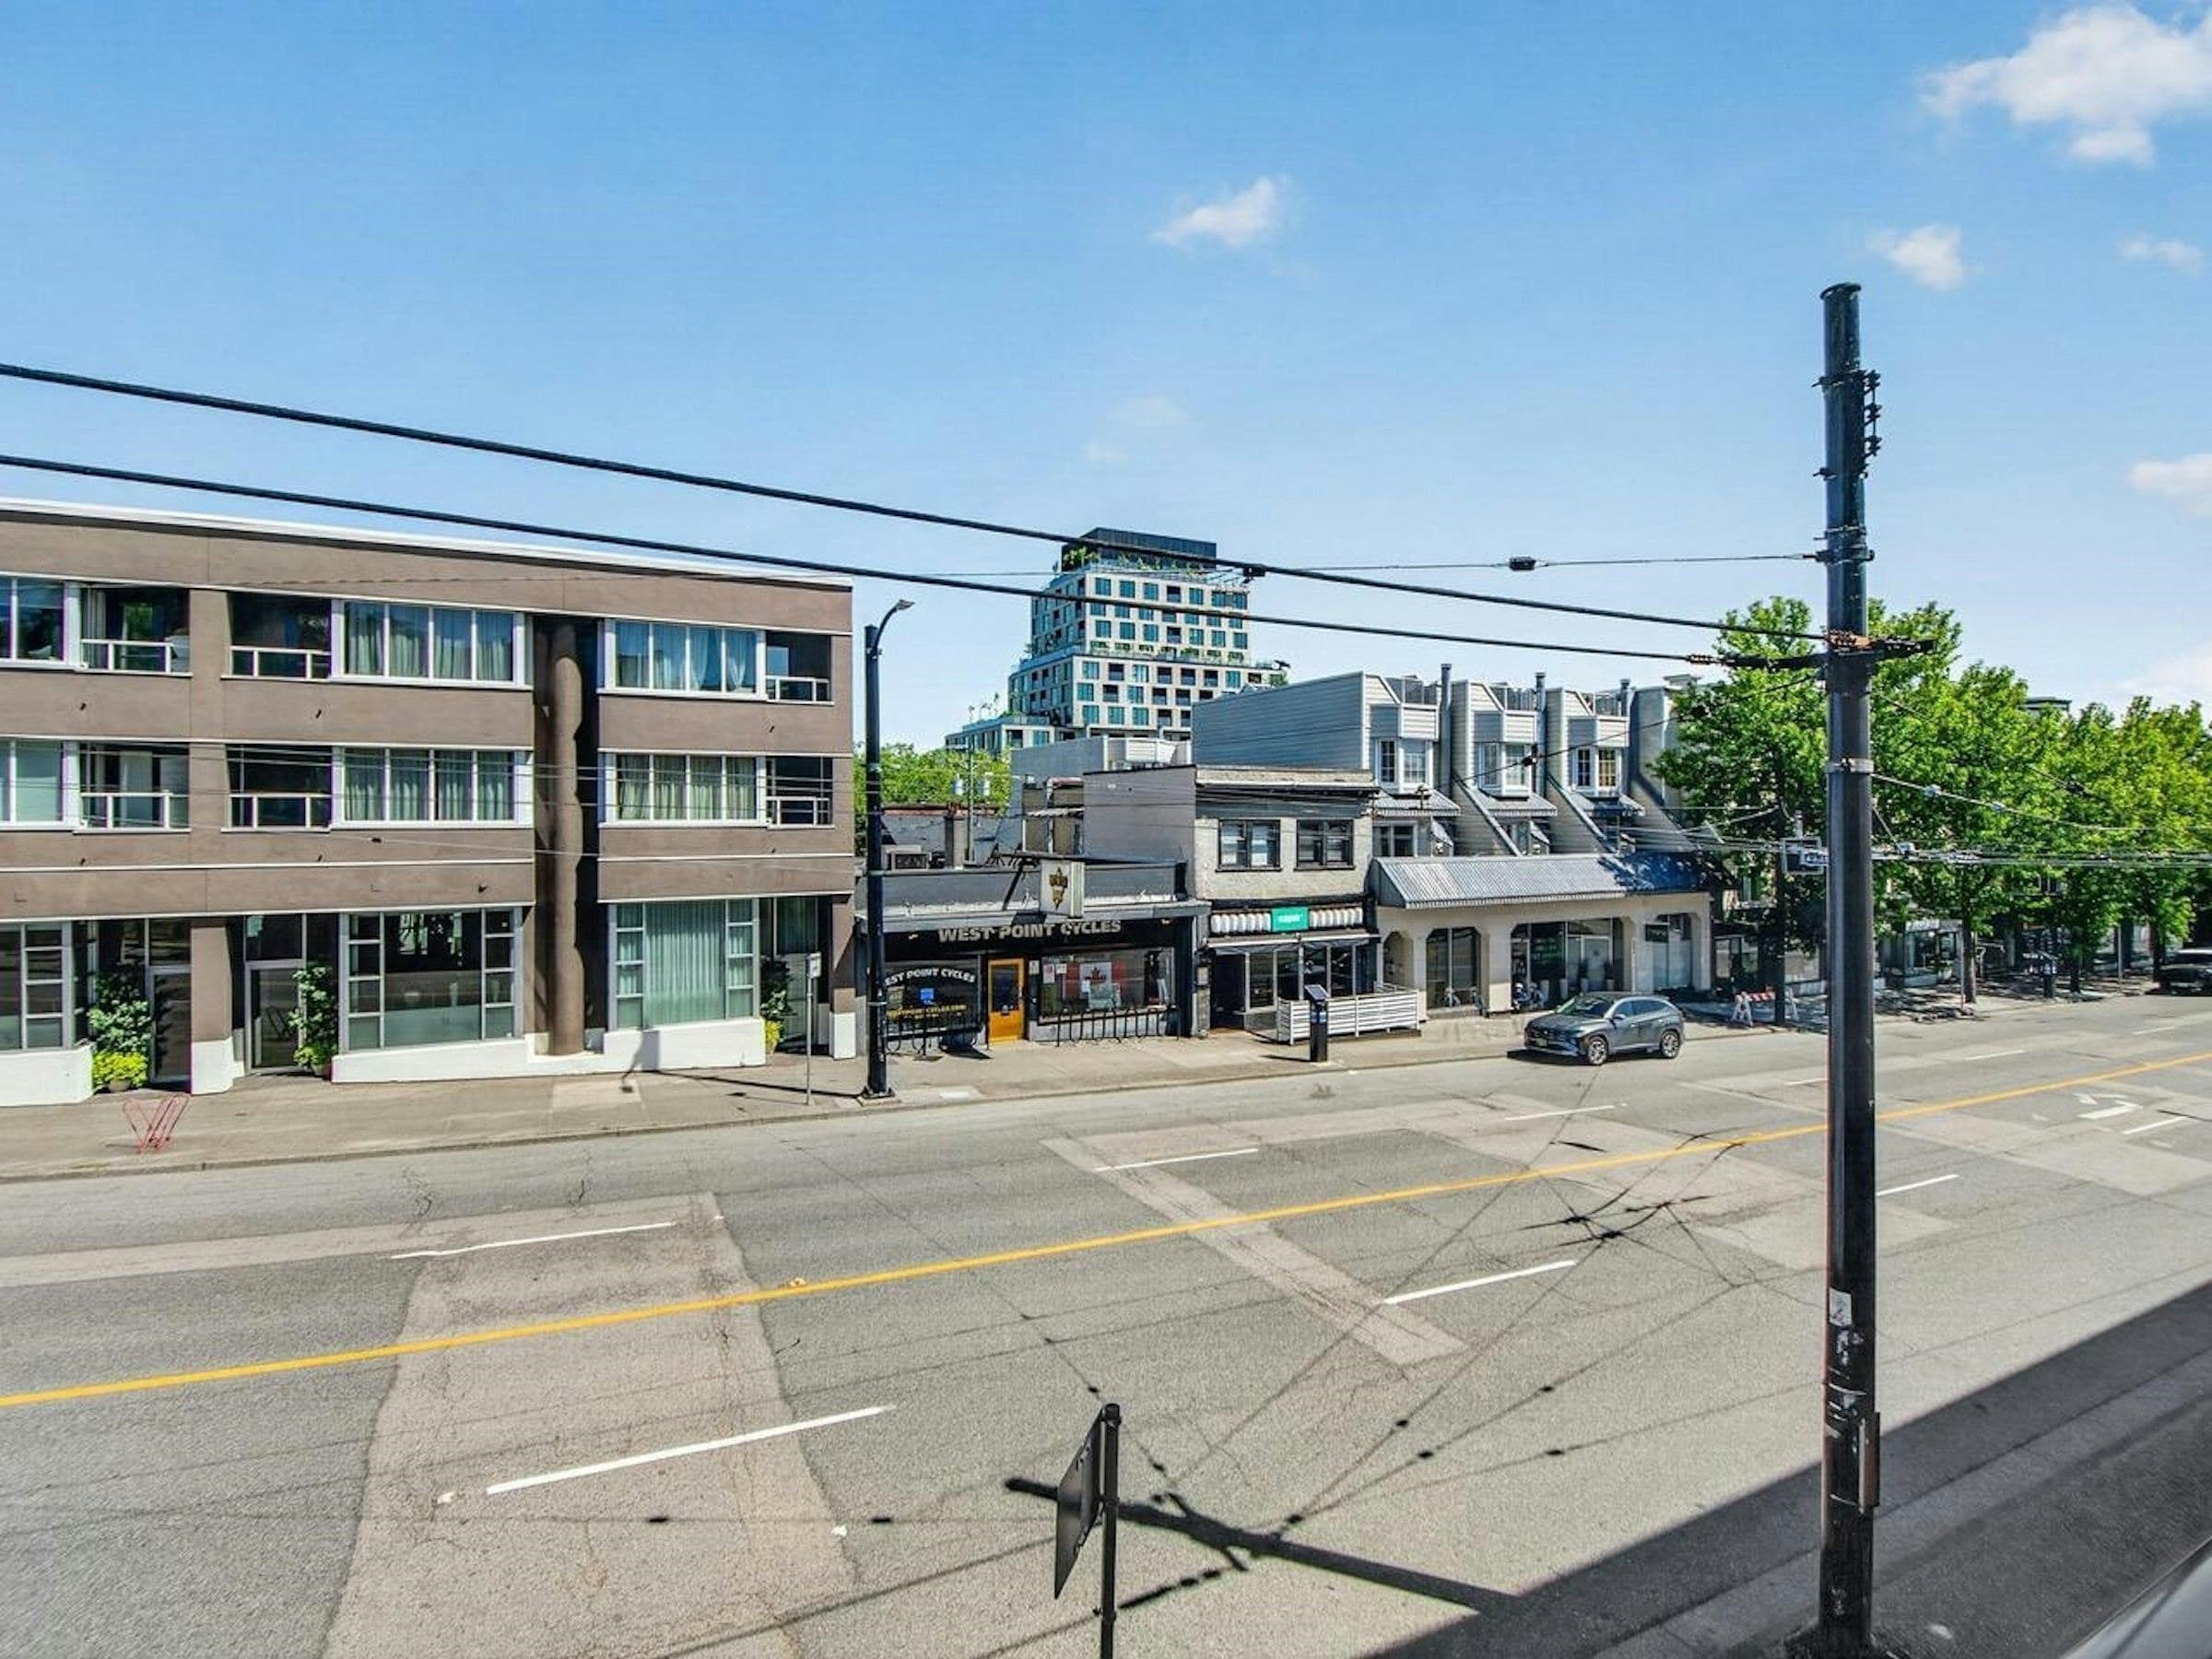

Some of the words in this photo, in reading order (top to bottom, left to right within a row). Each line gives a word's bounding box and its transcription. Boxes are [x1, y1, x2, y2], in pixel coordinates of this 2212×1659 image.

[938, 927, 993, 943] WEST
[998, 924, 1055, 938] POINT
[1061, 921, 1122, 935] CYCLES
[885, 971, 904, 985] EST
[906, 968, 939, 979] POINT
[941, 968, 976, 982] CYCLES
